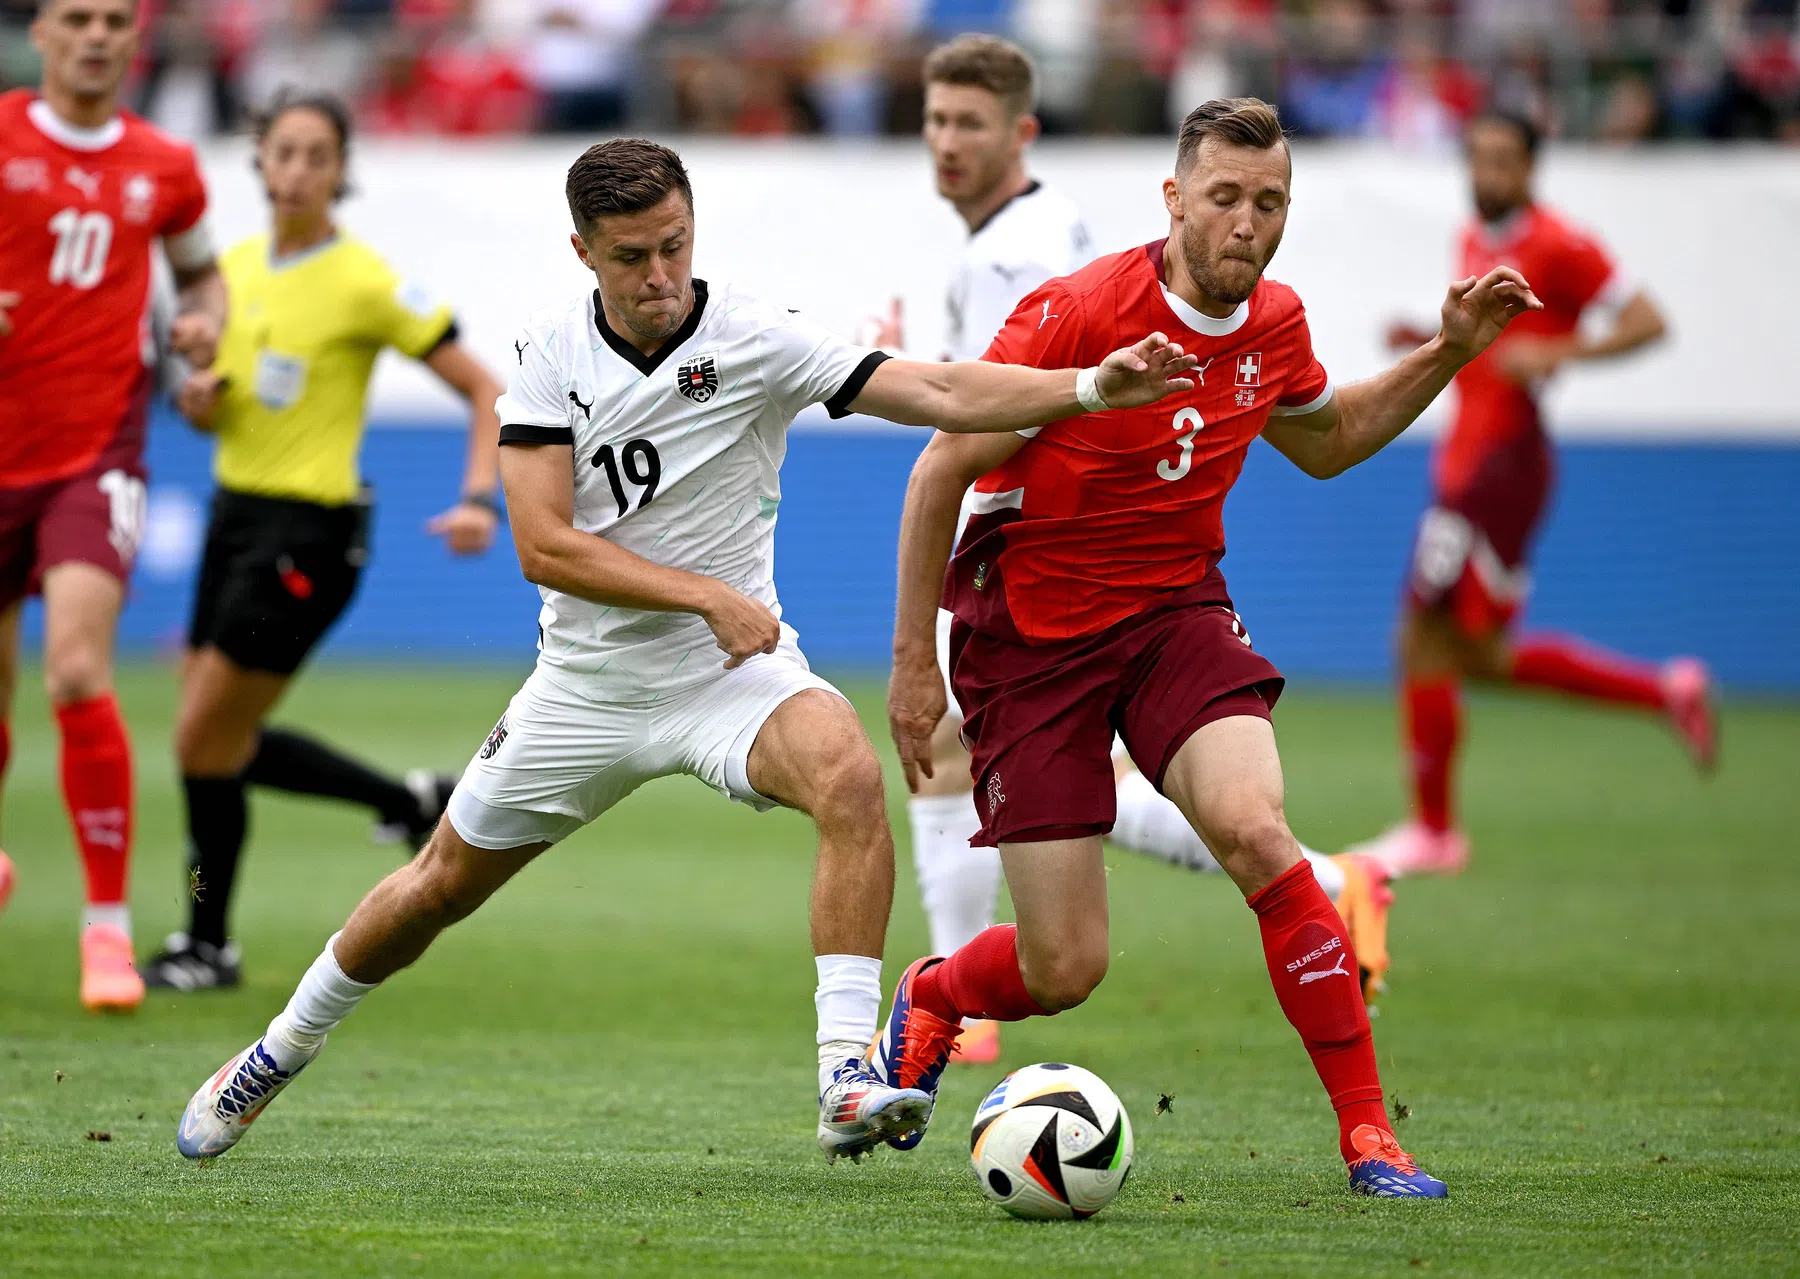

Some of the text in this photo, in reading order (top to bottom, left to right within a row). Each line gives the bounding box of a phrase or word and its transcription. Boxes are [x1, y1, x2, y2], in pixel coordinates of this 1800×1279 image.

[49, 207, 114, 290] 10
[591, 438, 661, 518] 19
[1156, 406, 1205, 481] 3
[1286, 936, 1342, 972] SUISSE
